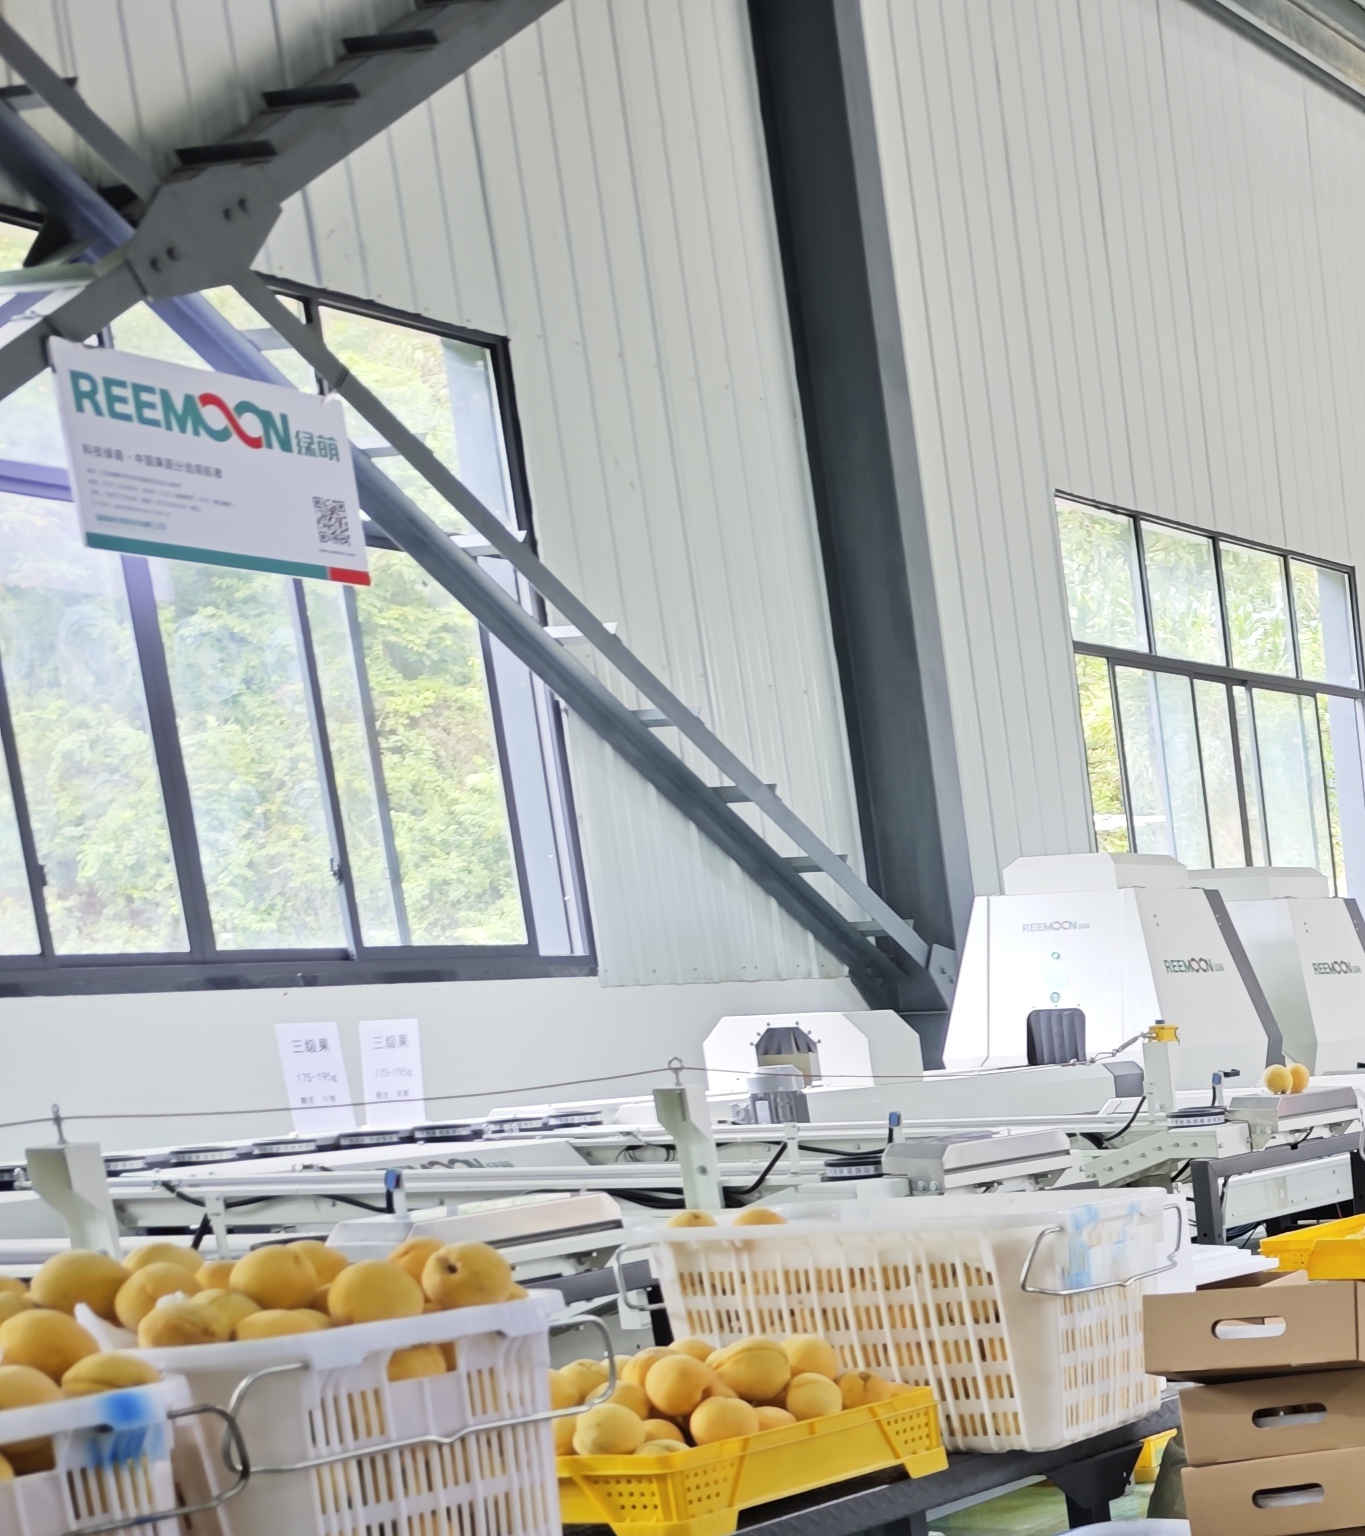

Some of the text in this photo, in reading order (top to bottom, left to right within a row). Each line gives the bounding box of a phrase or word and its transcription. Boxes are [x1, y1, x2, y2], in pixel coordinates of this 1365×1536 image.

[69, 369, 293, 454] REEMOON
[1163, 957, 1214, 974] REEMOON
[1312, 960, 1353, 975] REEMOON
